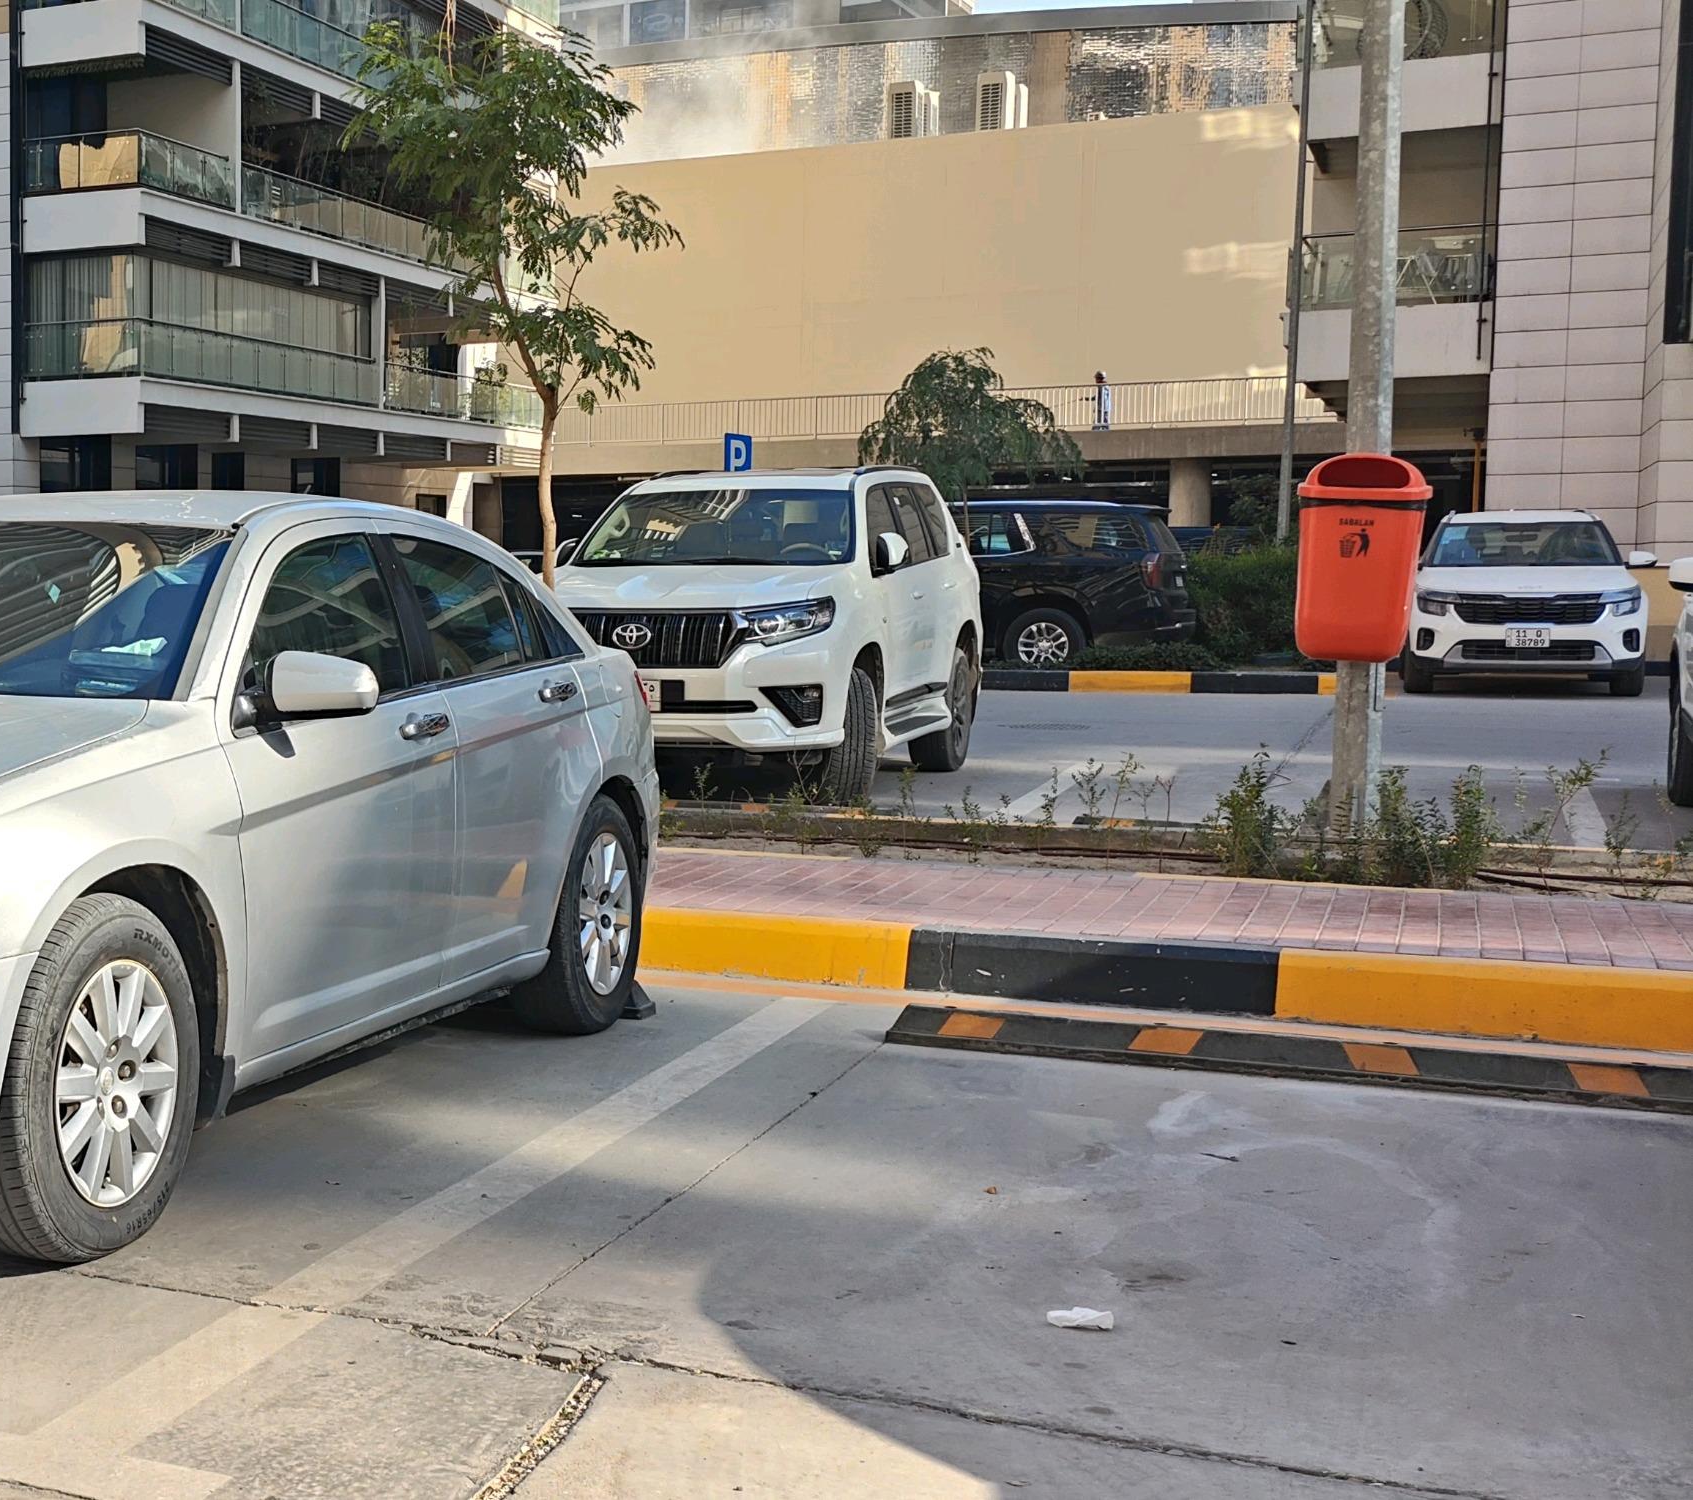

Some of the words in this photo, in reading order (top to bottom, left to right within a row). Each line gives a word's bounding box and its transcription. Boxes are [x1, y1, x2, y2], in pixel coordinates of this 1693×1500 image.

[729, 438, 747, 472] P
[1338, 518, 1375, 526] SABALAN
[1515, 630, 1527, 638] 11
[1515, 638, 1545, 647] 38789
